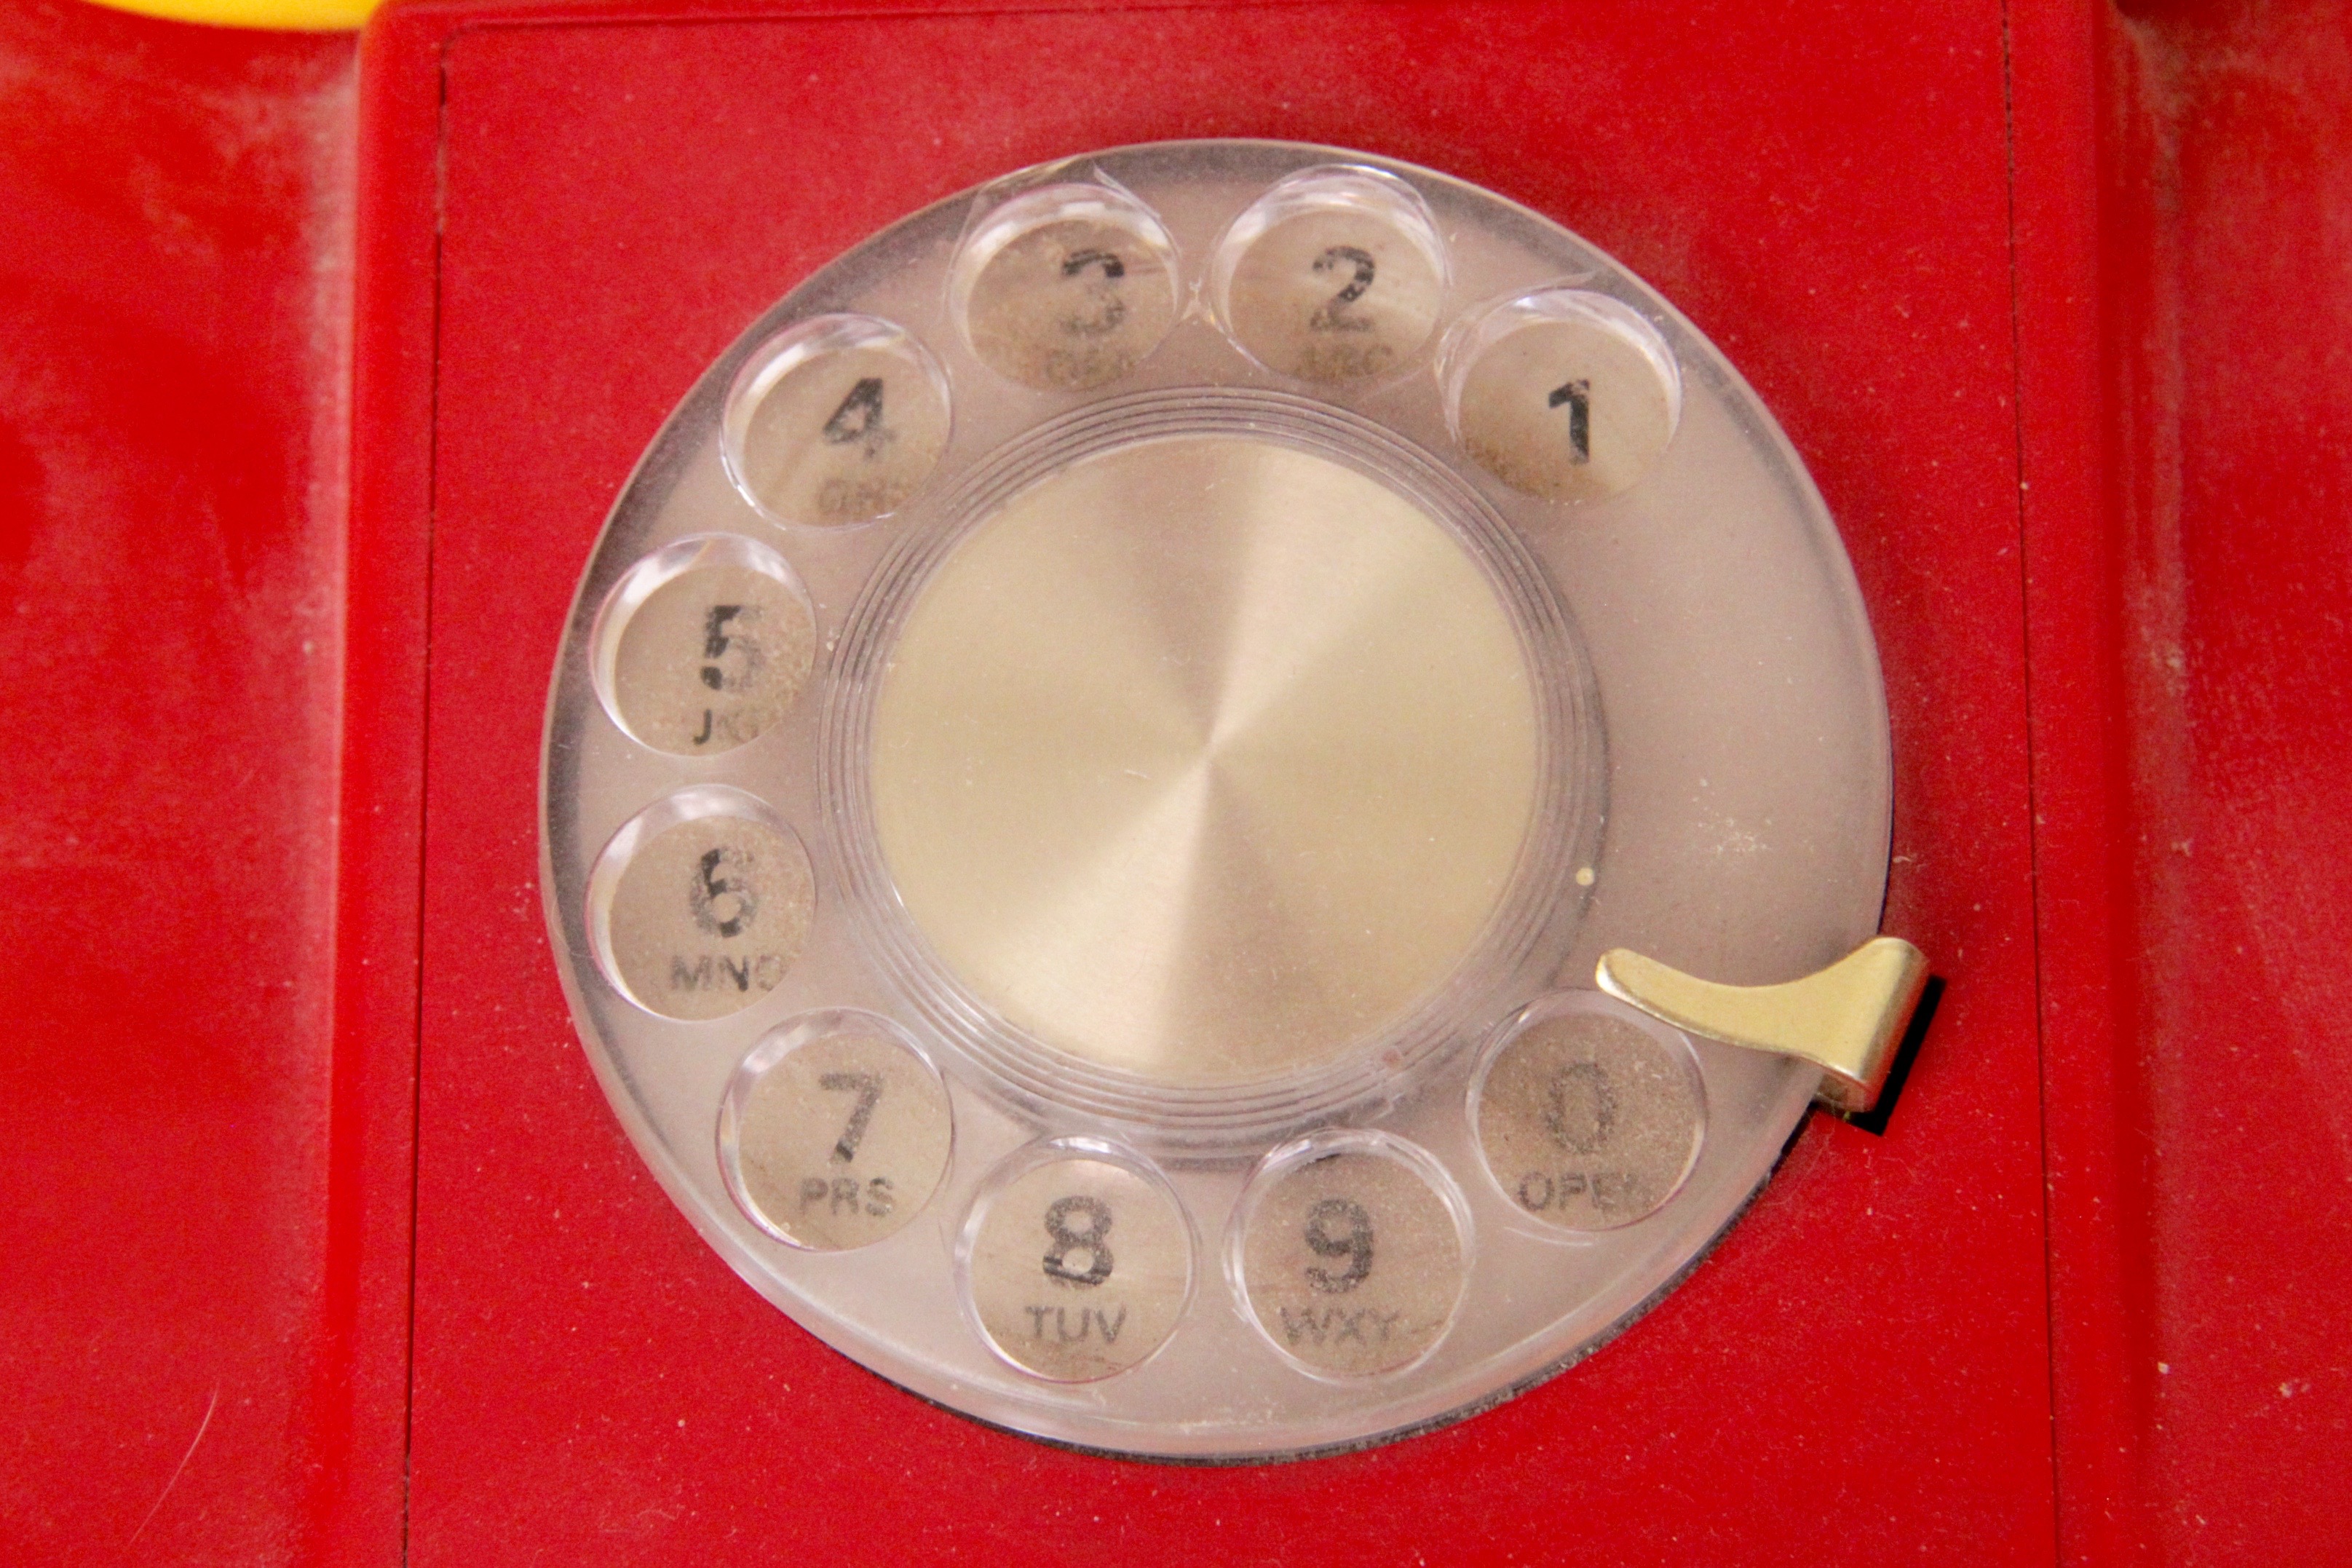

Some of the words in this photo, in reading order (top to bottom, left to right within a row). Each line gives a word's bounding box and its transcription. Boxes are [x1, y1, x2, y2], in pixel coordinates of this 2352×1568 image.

[1062, 248, 1125, 334] 3
[1310, 245, 1375, 330] 2
[823, 378, 897, 462] 4
[1548, 379, 1590, 465] 1
[700, 605, 762, 691] 5
[690, 846, 759, 938] 6
[818, 1072, 884, 1164] 7
[801, 1176, 894, 1217] PRS
[1043, 1195, 1114, 1287] 8
[1303, 1200, 1374, 1294] 9
[1025, 1305, 1127, 1343] TUV
[1279, 1307, 1401, 1345] WXY
